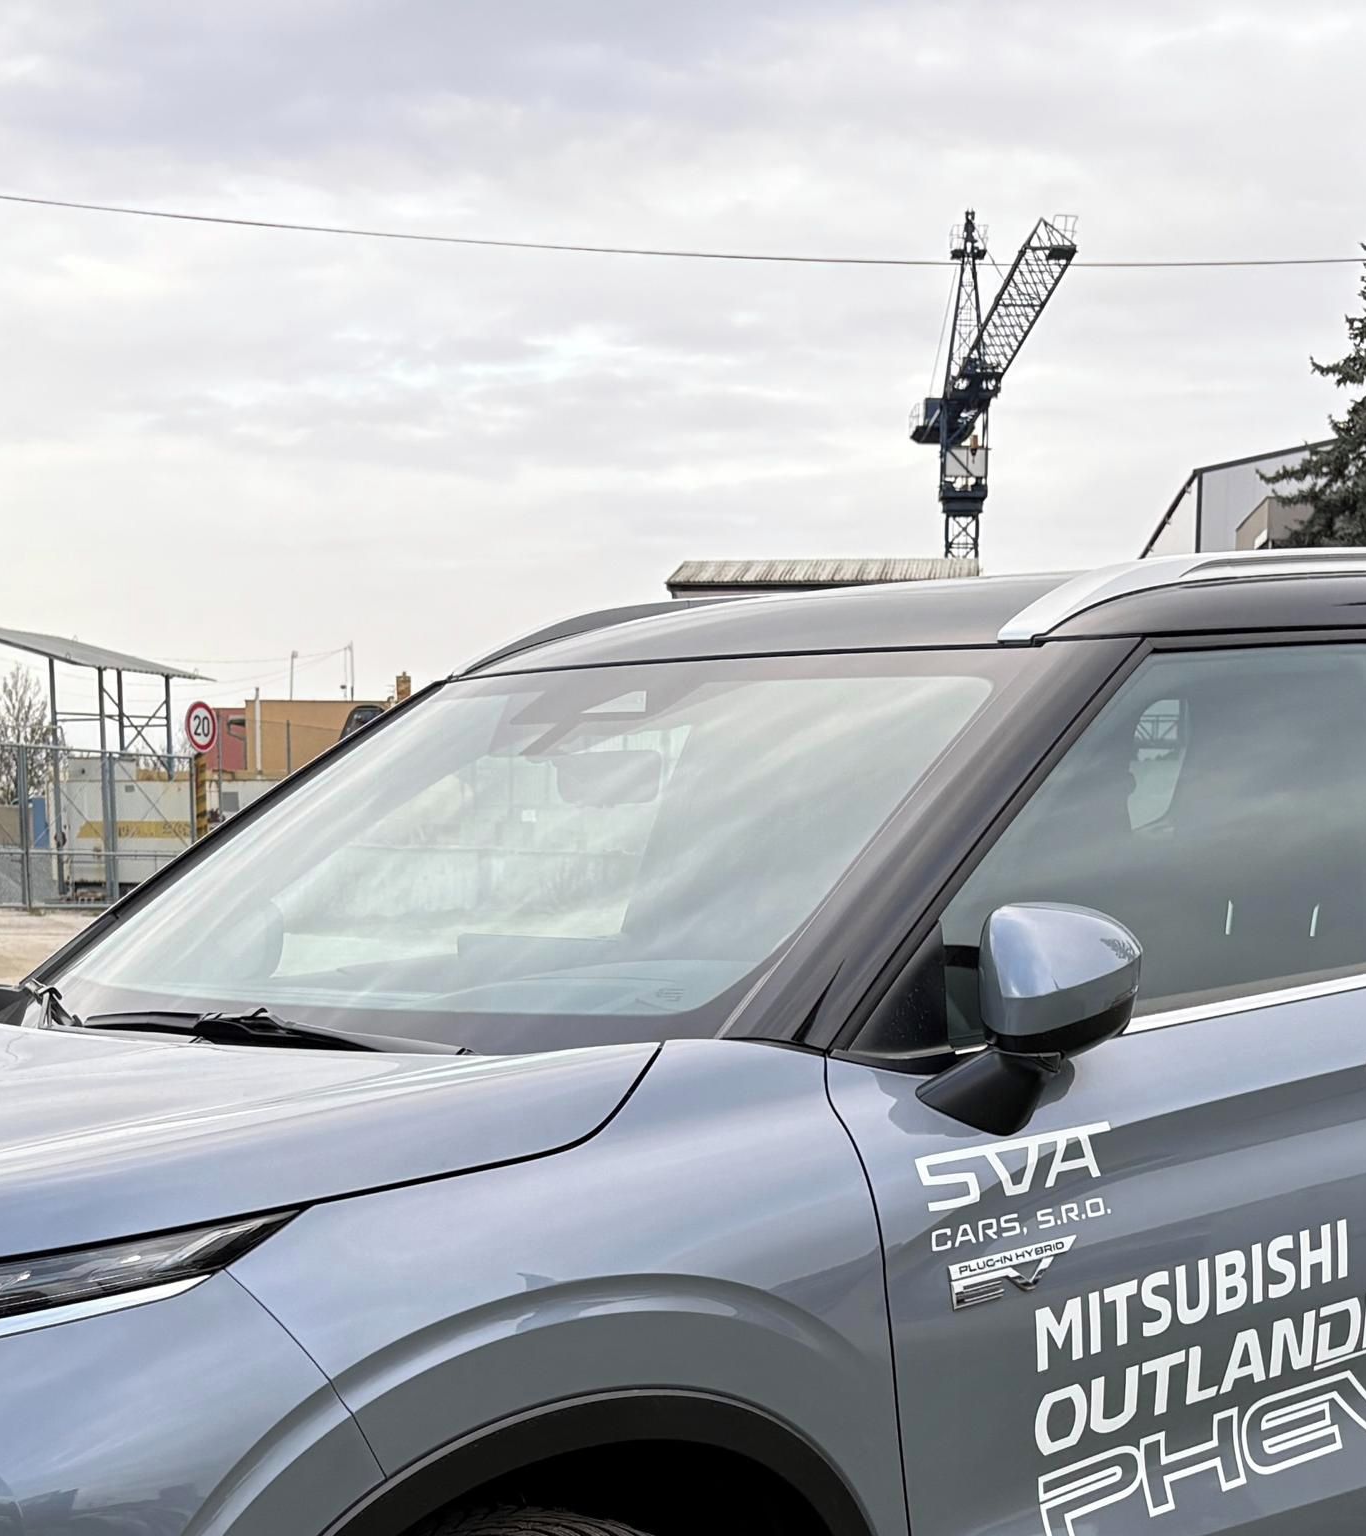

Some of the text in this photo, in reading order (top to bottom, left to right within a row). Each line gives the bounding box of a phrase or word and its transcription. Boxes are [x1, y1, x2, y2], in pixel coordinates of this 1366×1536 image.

[193, 714, 210, 737] 20
[914, 1121, 1112, 1212] SVA
[931, 1197, 1112, 1252] CARS, S.R.O.
[958, 1241, 1065, 1275] PLUG-IN HYBRID
[1035, 1218, 1348, 1373] MITSUBISHI
